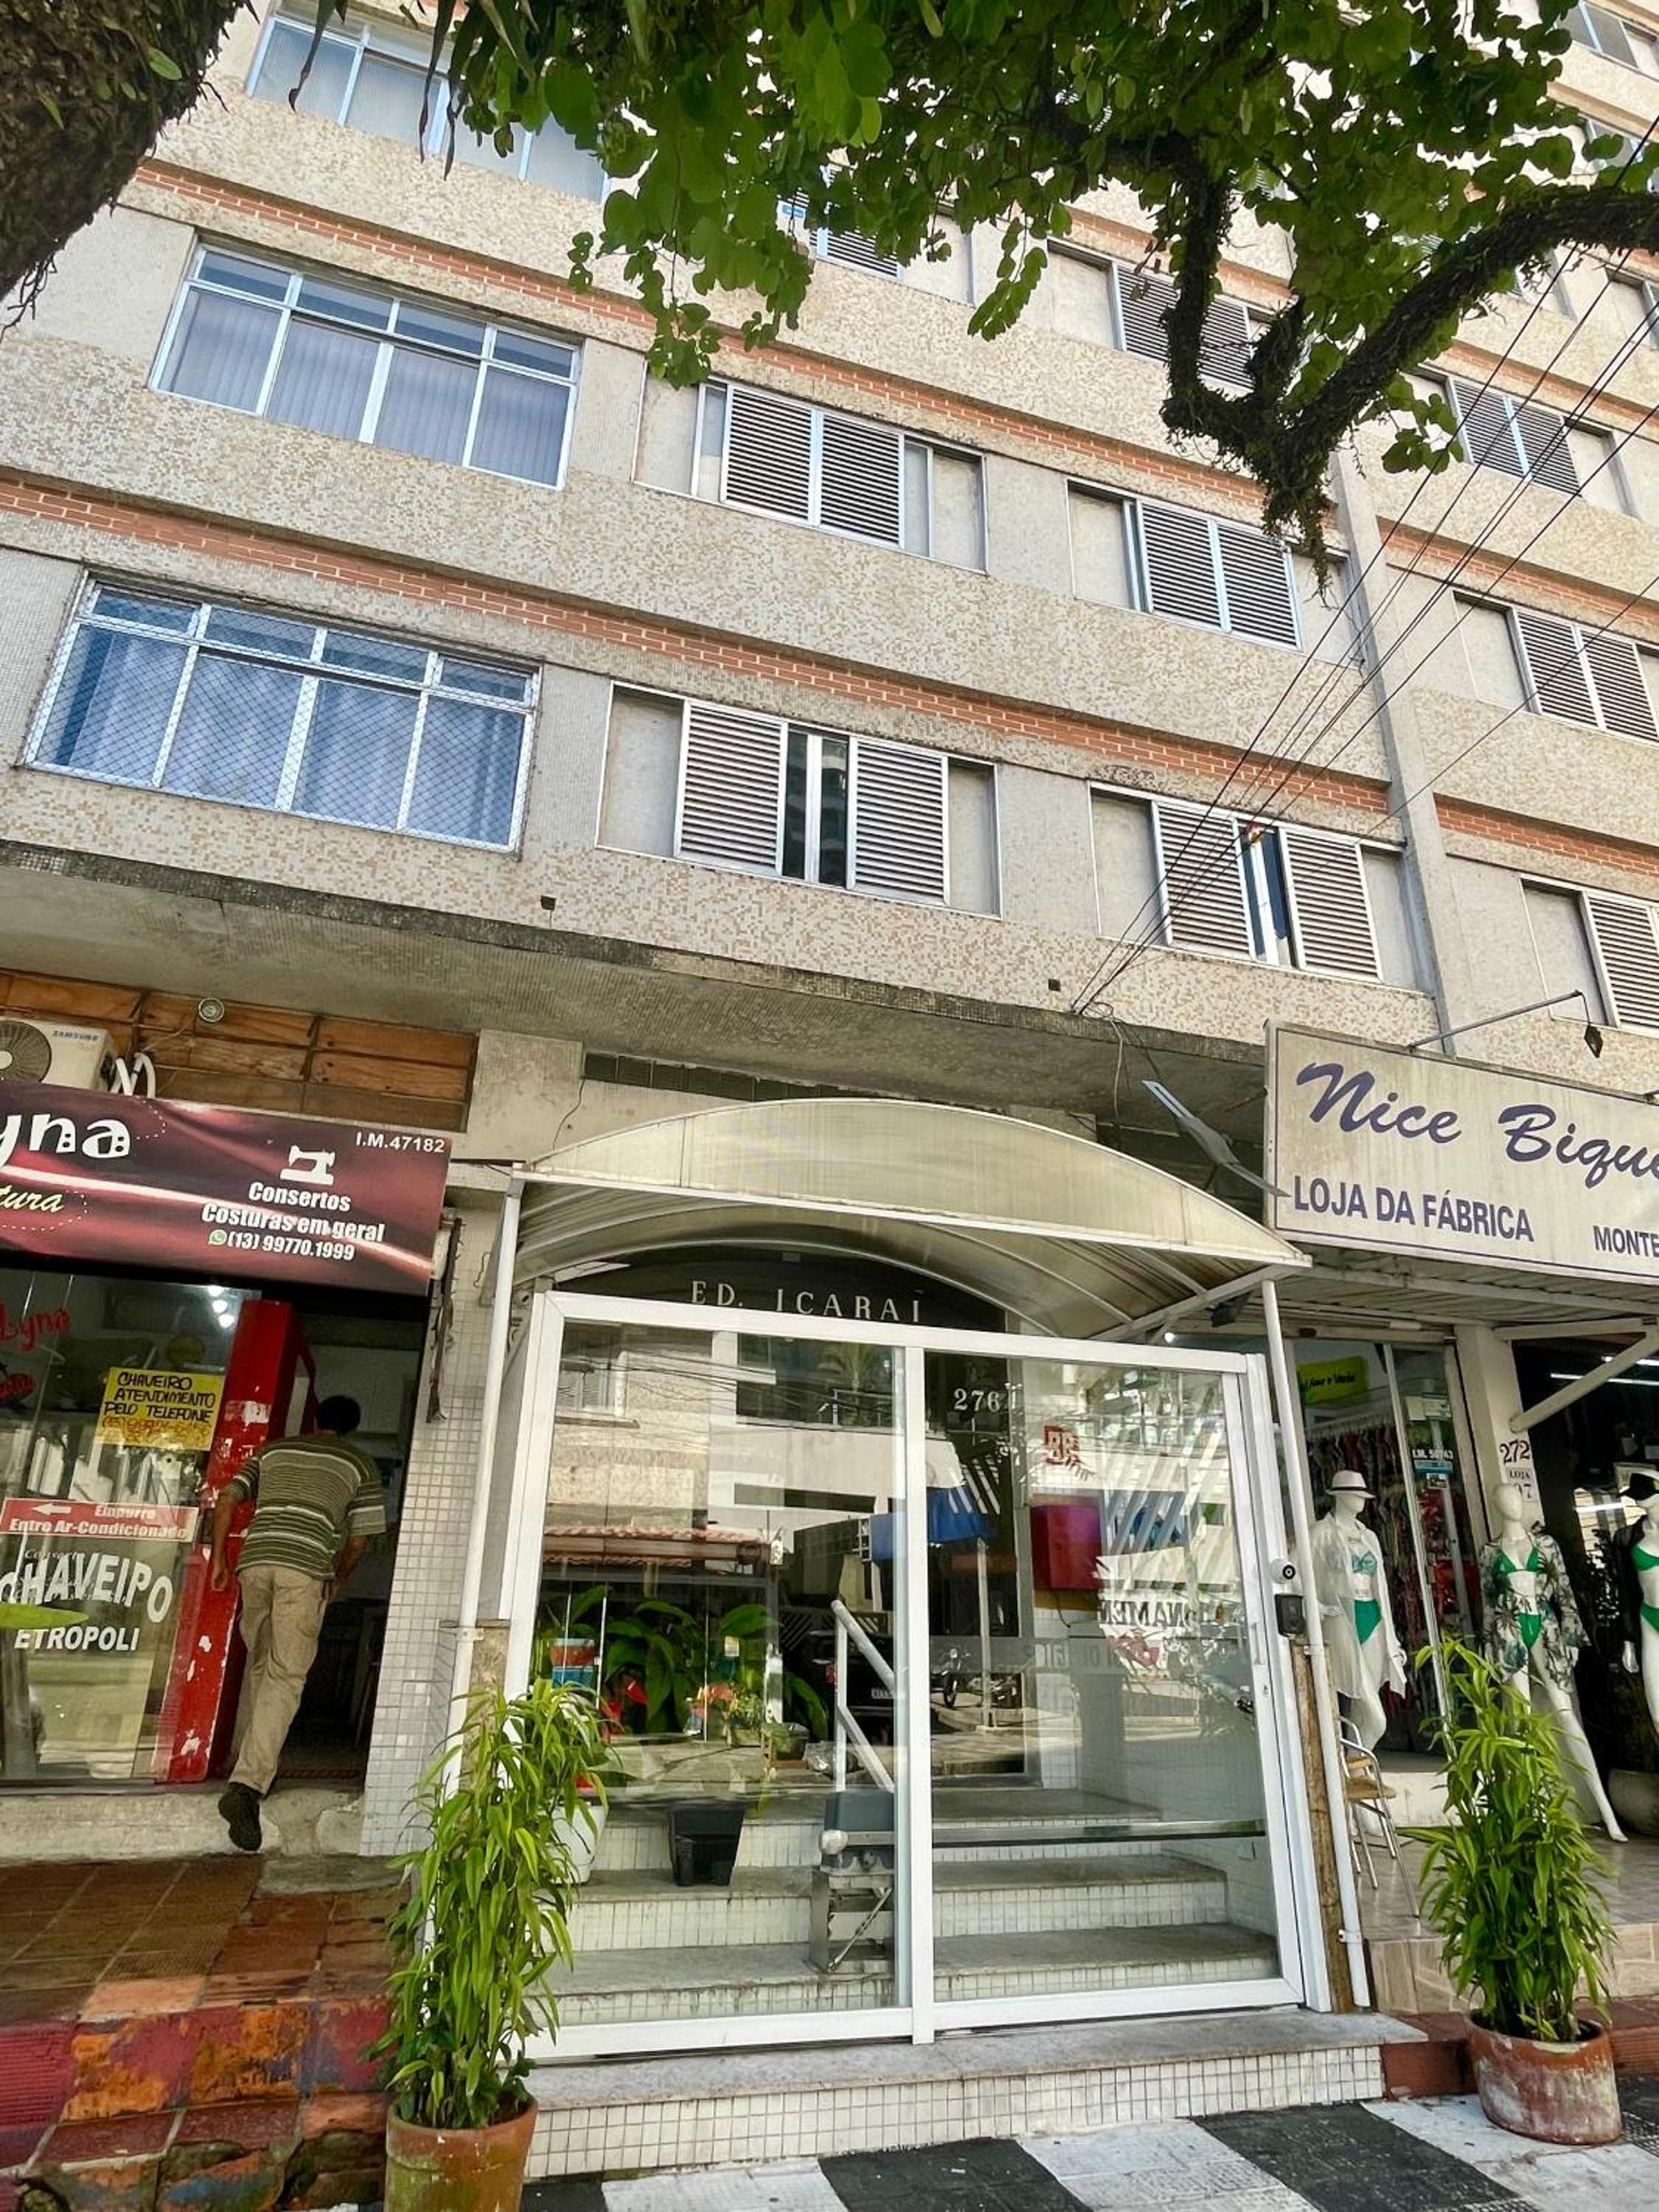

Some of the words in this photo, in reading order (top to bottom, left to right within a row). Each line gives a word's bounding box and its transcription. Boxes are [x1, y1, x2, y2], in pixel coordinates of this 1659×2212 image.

[1295, 1062, 1462, 1144] Nice
[248, 1182, 352, 1212] Consertos
[1294, 1175, 1368, 1219] LOJA
[1376, 1187, 1416, 1225] DA
[1423, 1189, 1534, 1242] FÁBRICA
[202, 1203, 296, 1232] Costuras
[297, 1217, 330, 1236] em
[331, 1222, 386, 1242] geral
[227, 1231, 260, 1251] (13)
[262, 1236, 355, 1261] 99770.1999
[692, 1281, 743, 1307] ED.
[118, 1371, 192, 1391] CHAVEIRO
[114, 1388, 216, 1408] ATENDIMENTO
[954, 1388, 1001, 1413] 276
[104, 1402, 137, 1416] PELO
[146, 1405, 213, 1424] TELEFONE
[1500, 1439, 1530, 1465] 272
